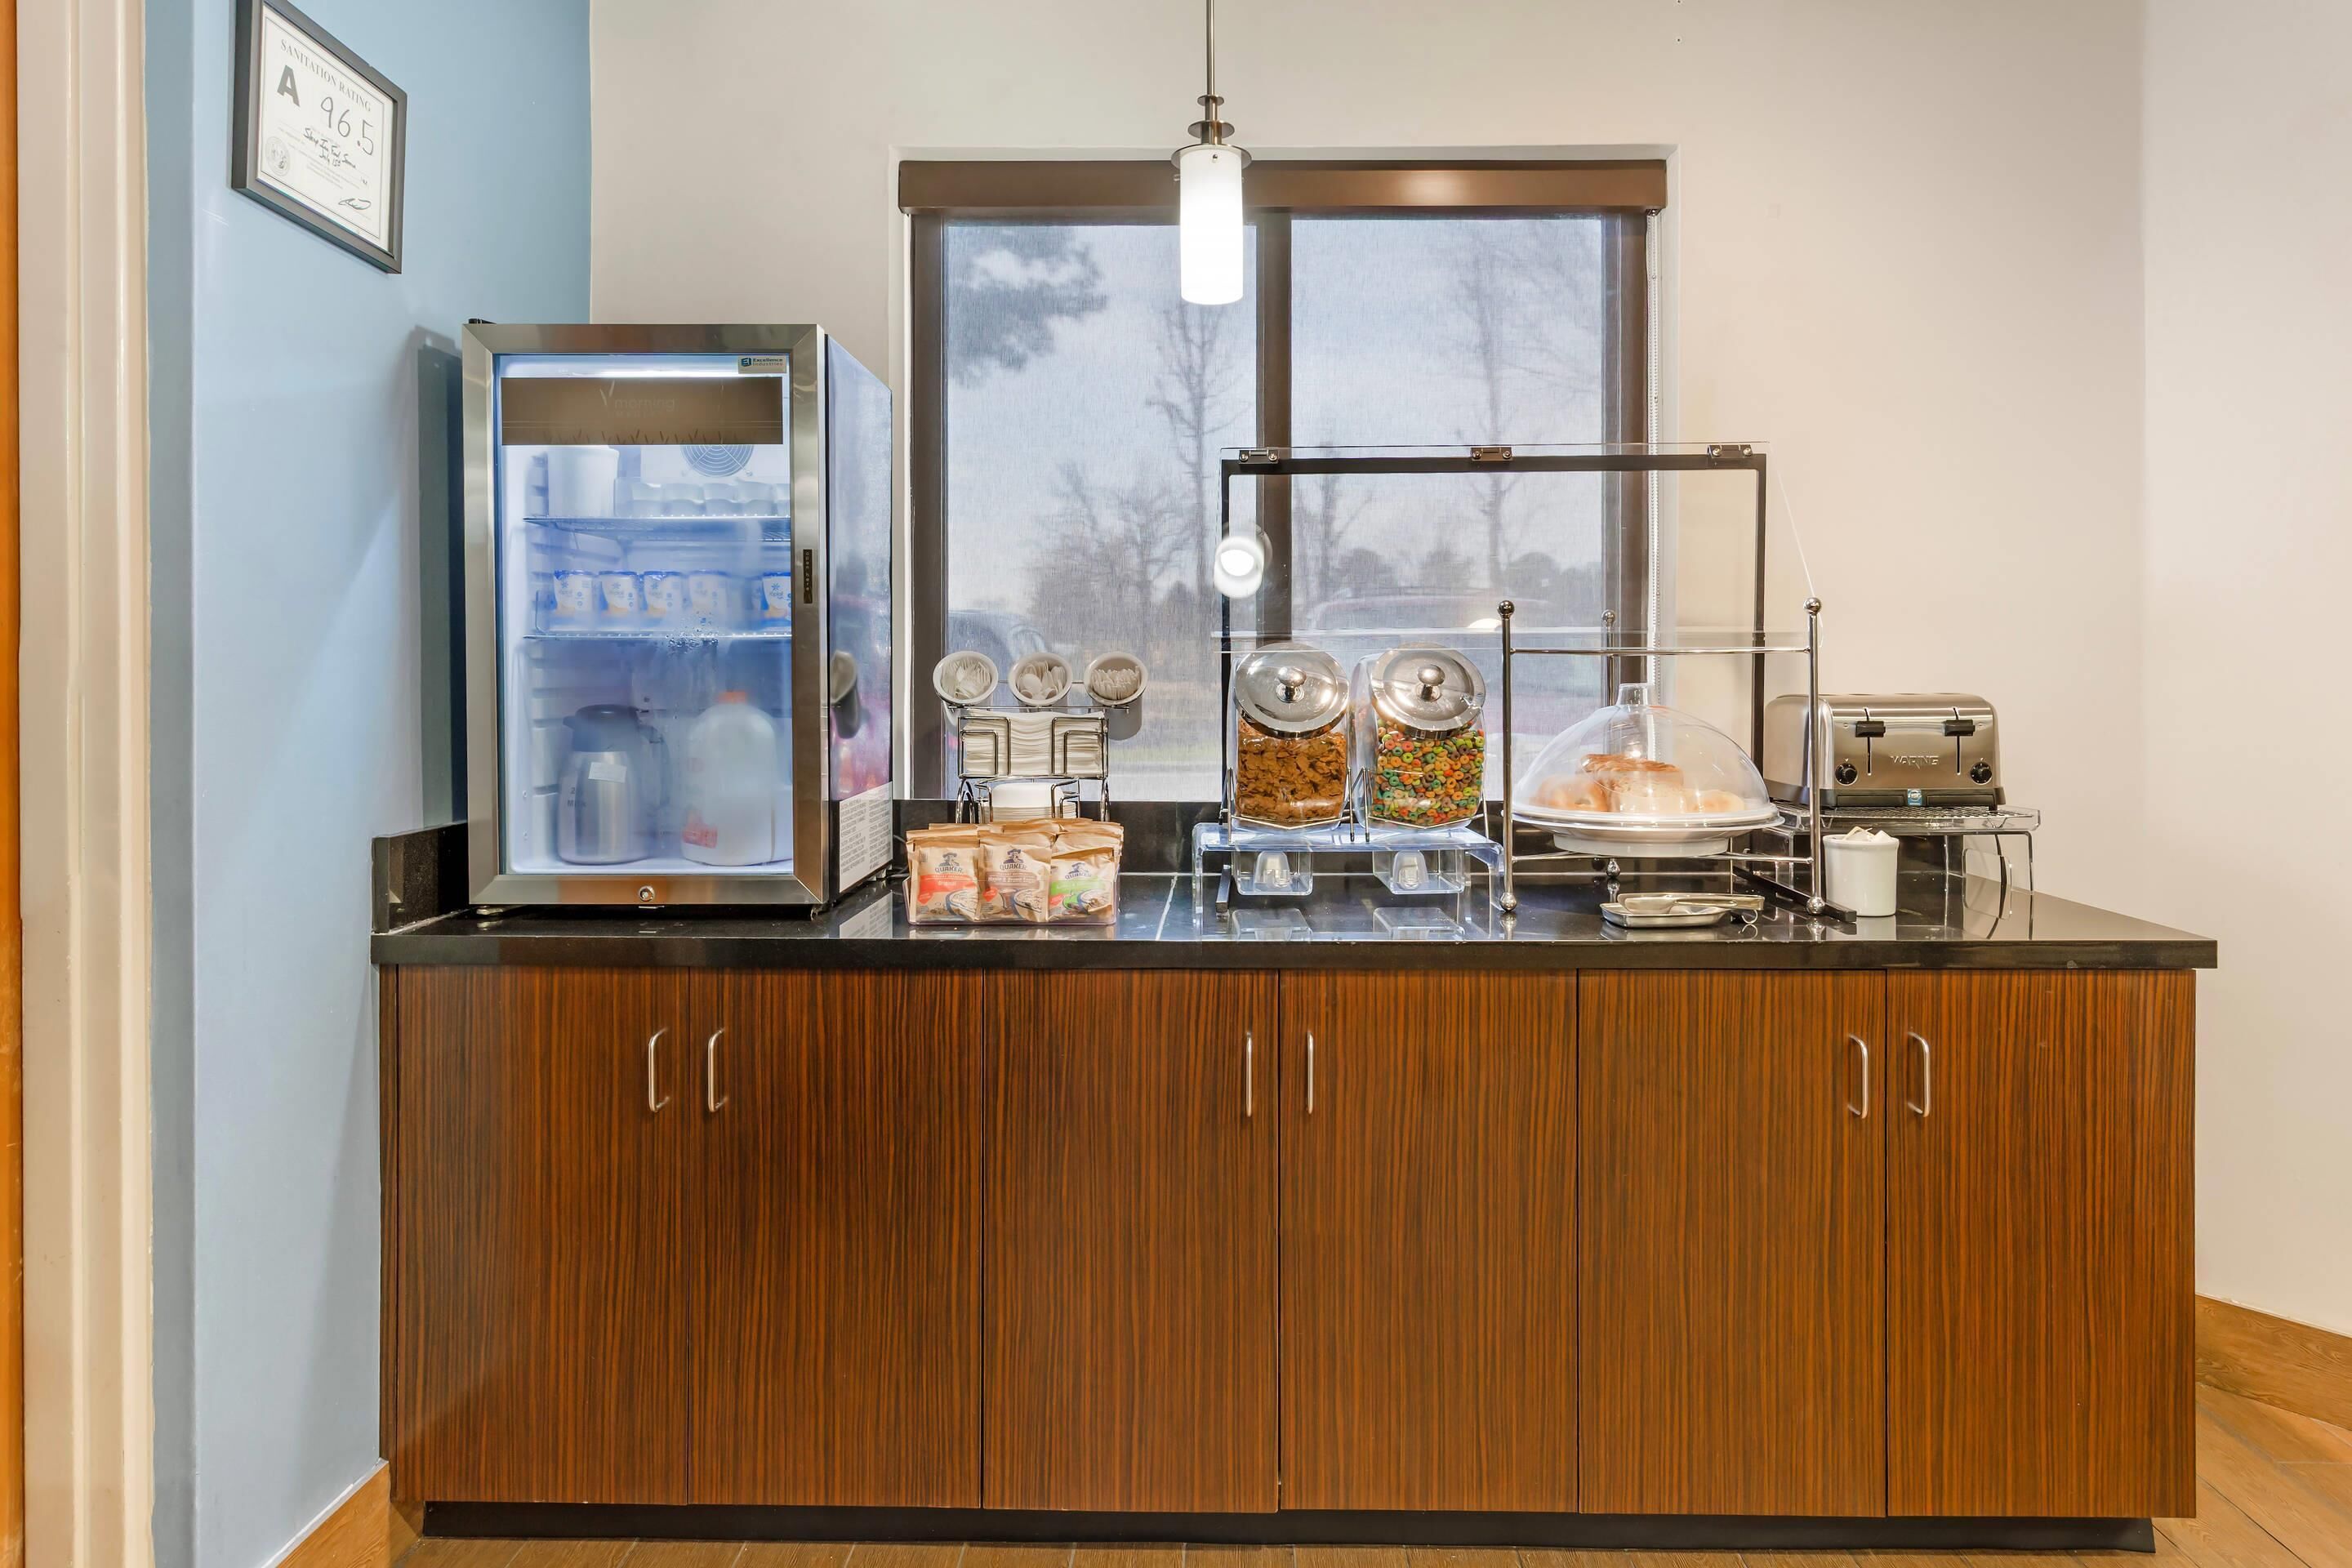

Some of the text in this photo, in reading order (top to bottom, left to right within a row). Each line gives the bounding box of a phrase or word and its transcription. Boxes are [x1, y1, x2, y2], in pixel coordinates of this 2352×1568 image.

[277, 65, 301, 108] A
[280, 38, 372, 112] SANITATION RATING
[1890, 755, 1939, 769] WARING
[1064, 871, 1092, 880] QUAKER
